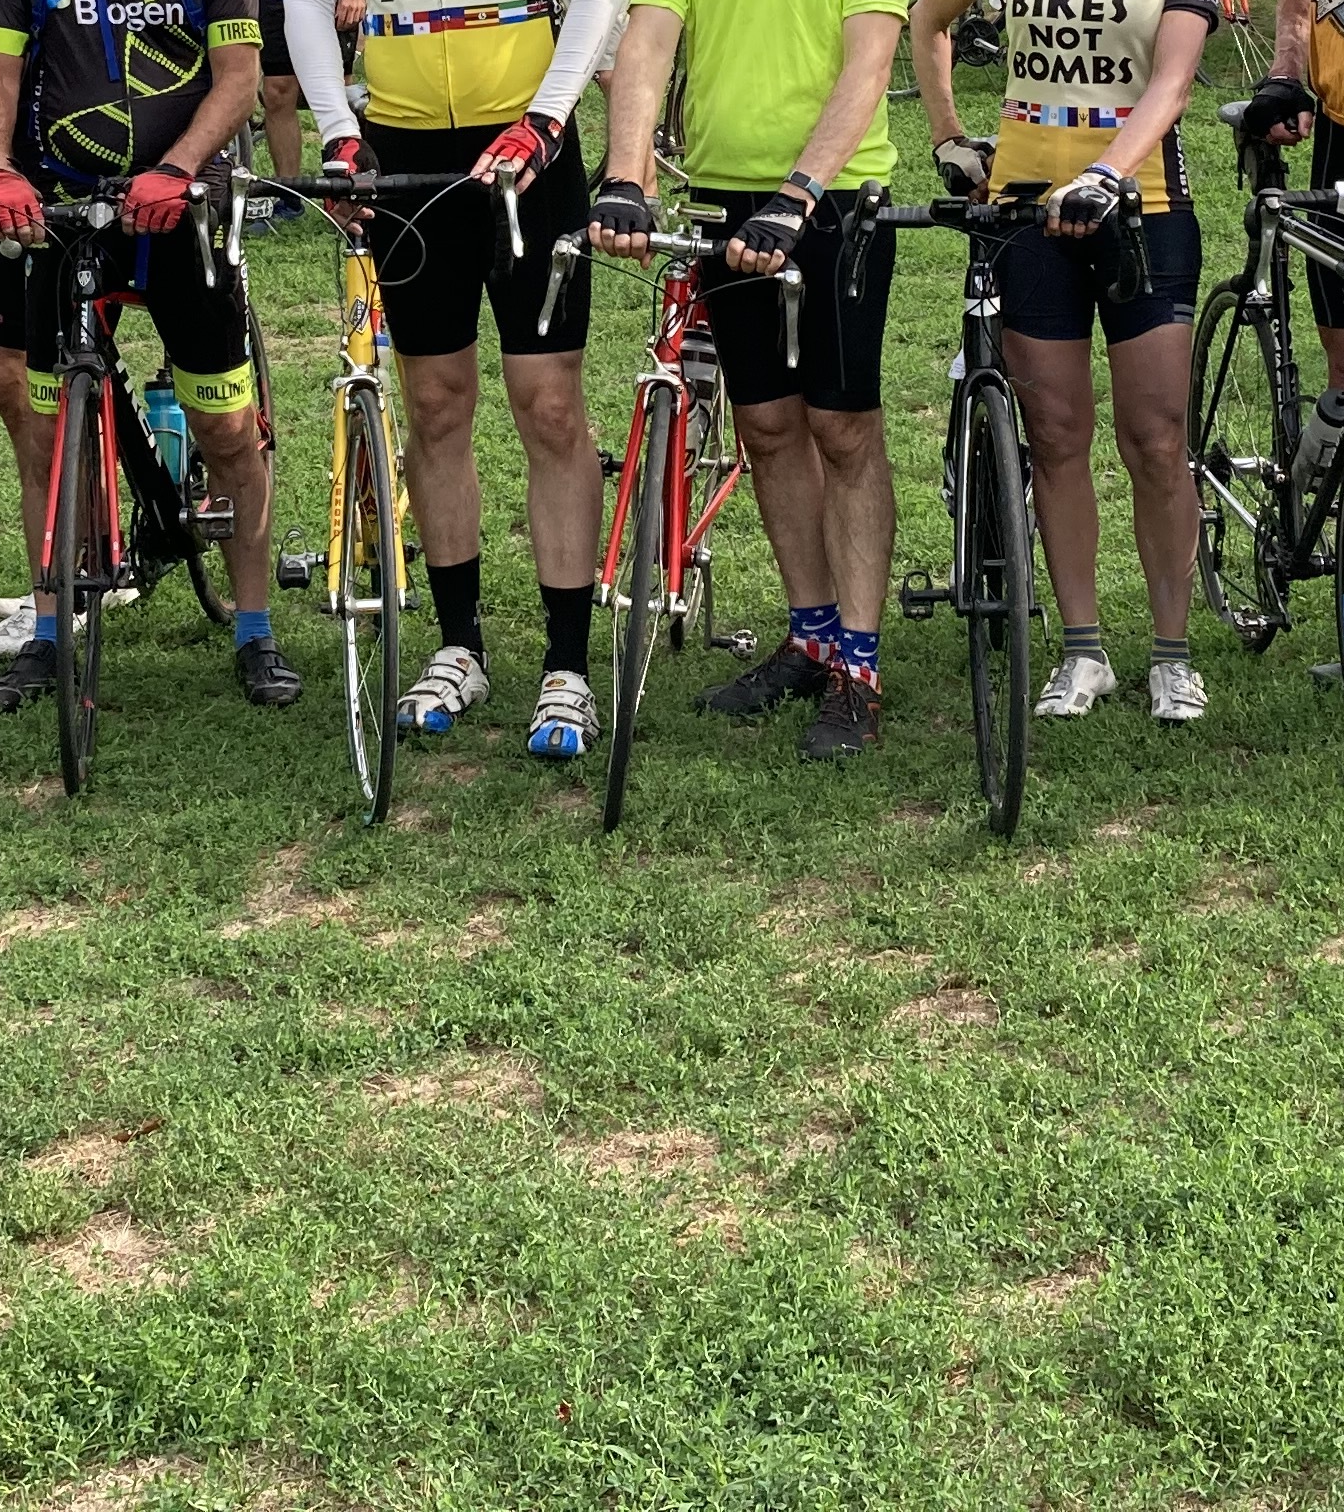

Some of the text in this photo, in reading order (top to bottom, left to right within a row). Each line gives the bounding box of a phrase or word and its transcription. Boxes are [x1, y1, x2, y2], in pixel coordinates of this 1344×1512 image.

[1028, 23, 1103, 51] NOT
[1013, 50, 1133, 85] BOMBS
[196, 381, 246, 401] ROLLING
